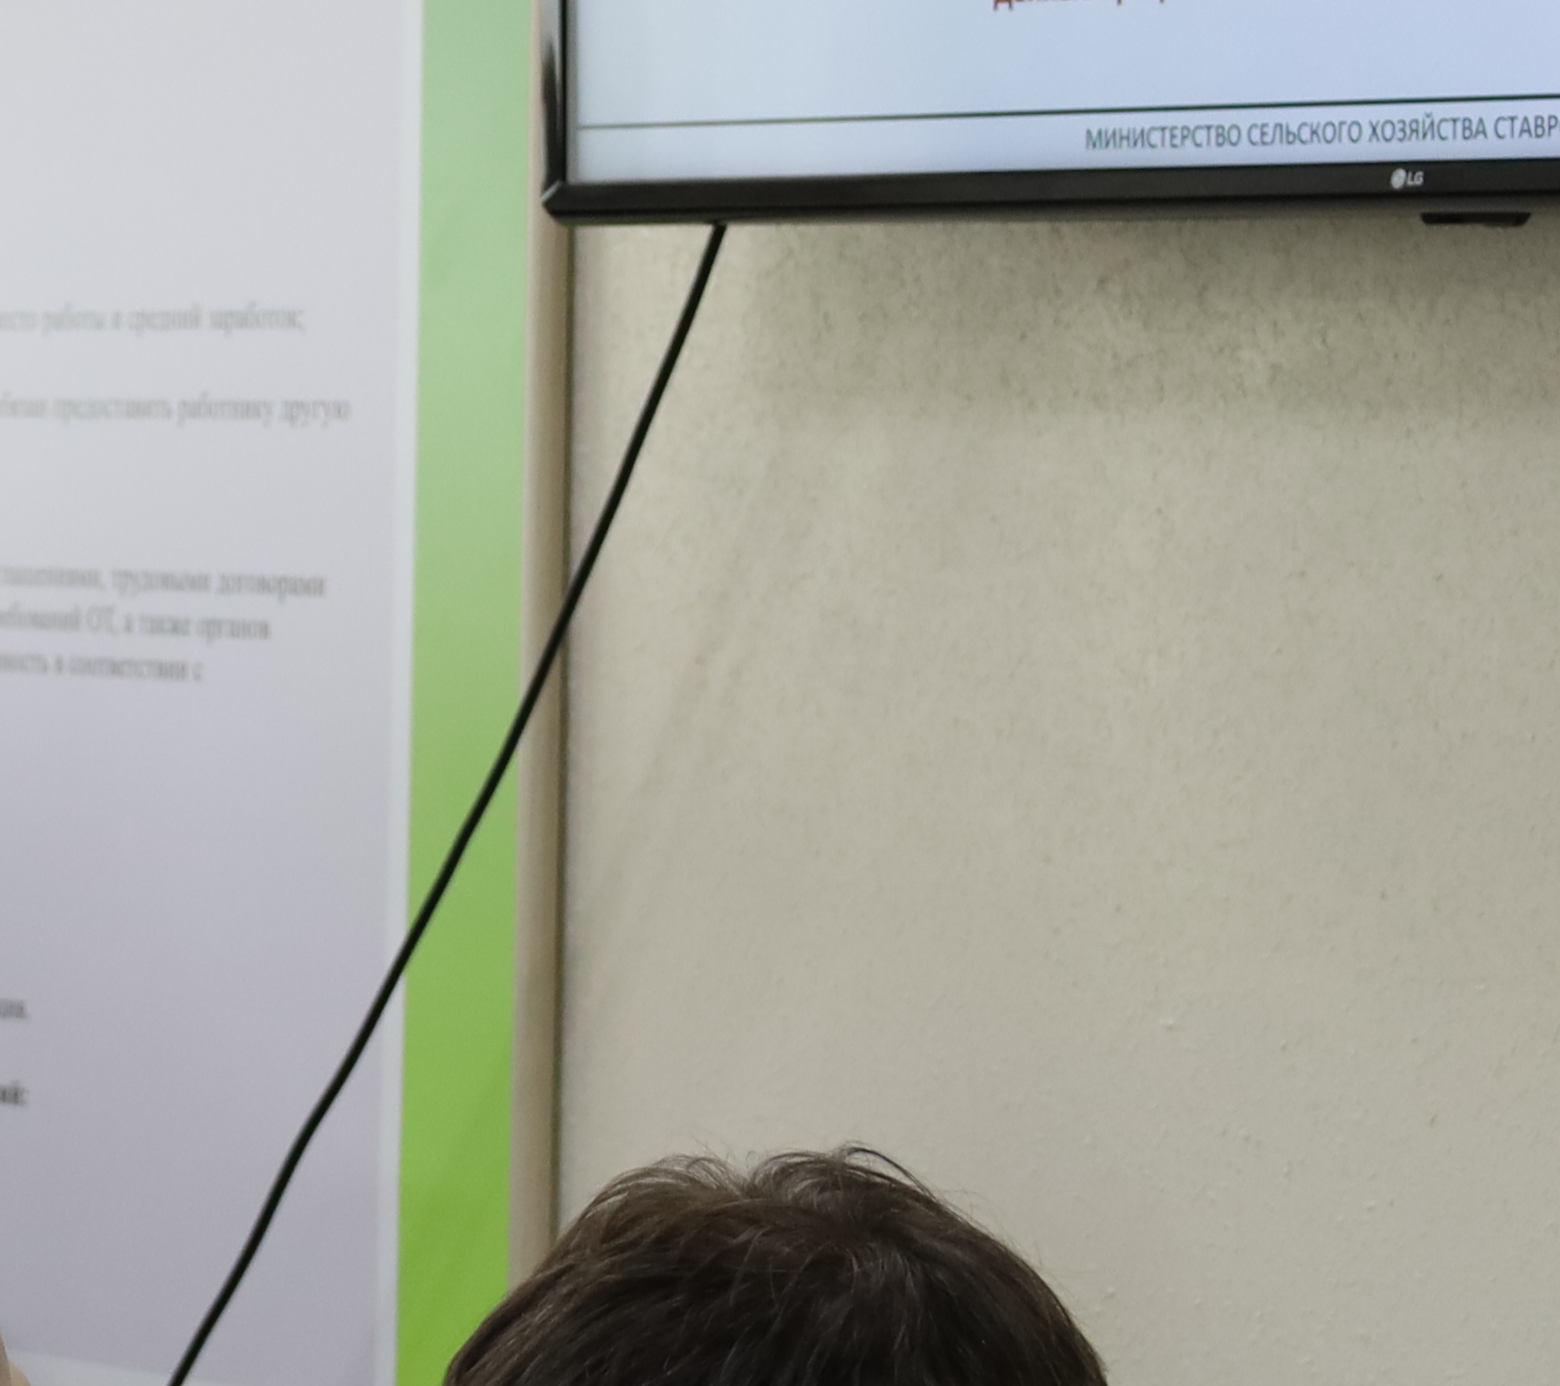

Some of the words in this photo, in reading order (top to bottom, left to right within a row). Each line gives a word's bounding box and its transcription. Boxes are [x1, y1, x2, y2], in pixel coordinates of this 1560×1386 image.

[1086, 124, 1242, 150] МИНИСТЕРСТВО
[1247, 121, 1363, 146] СЕЛЬСКОГО
[1368, 113, 1488, 143] ХОЗЯЙСТВА
